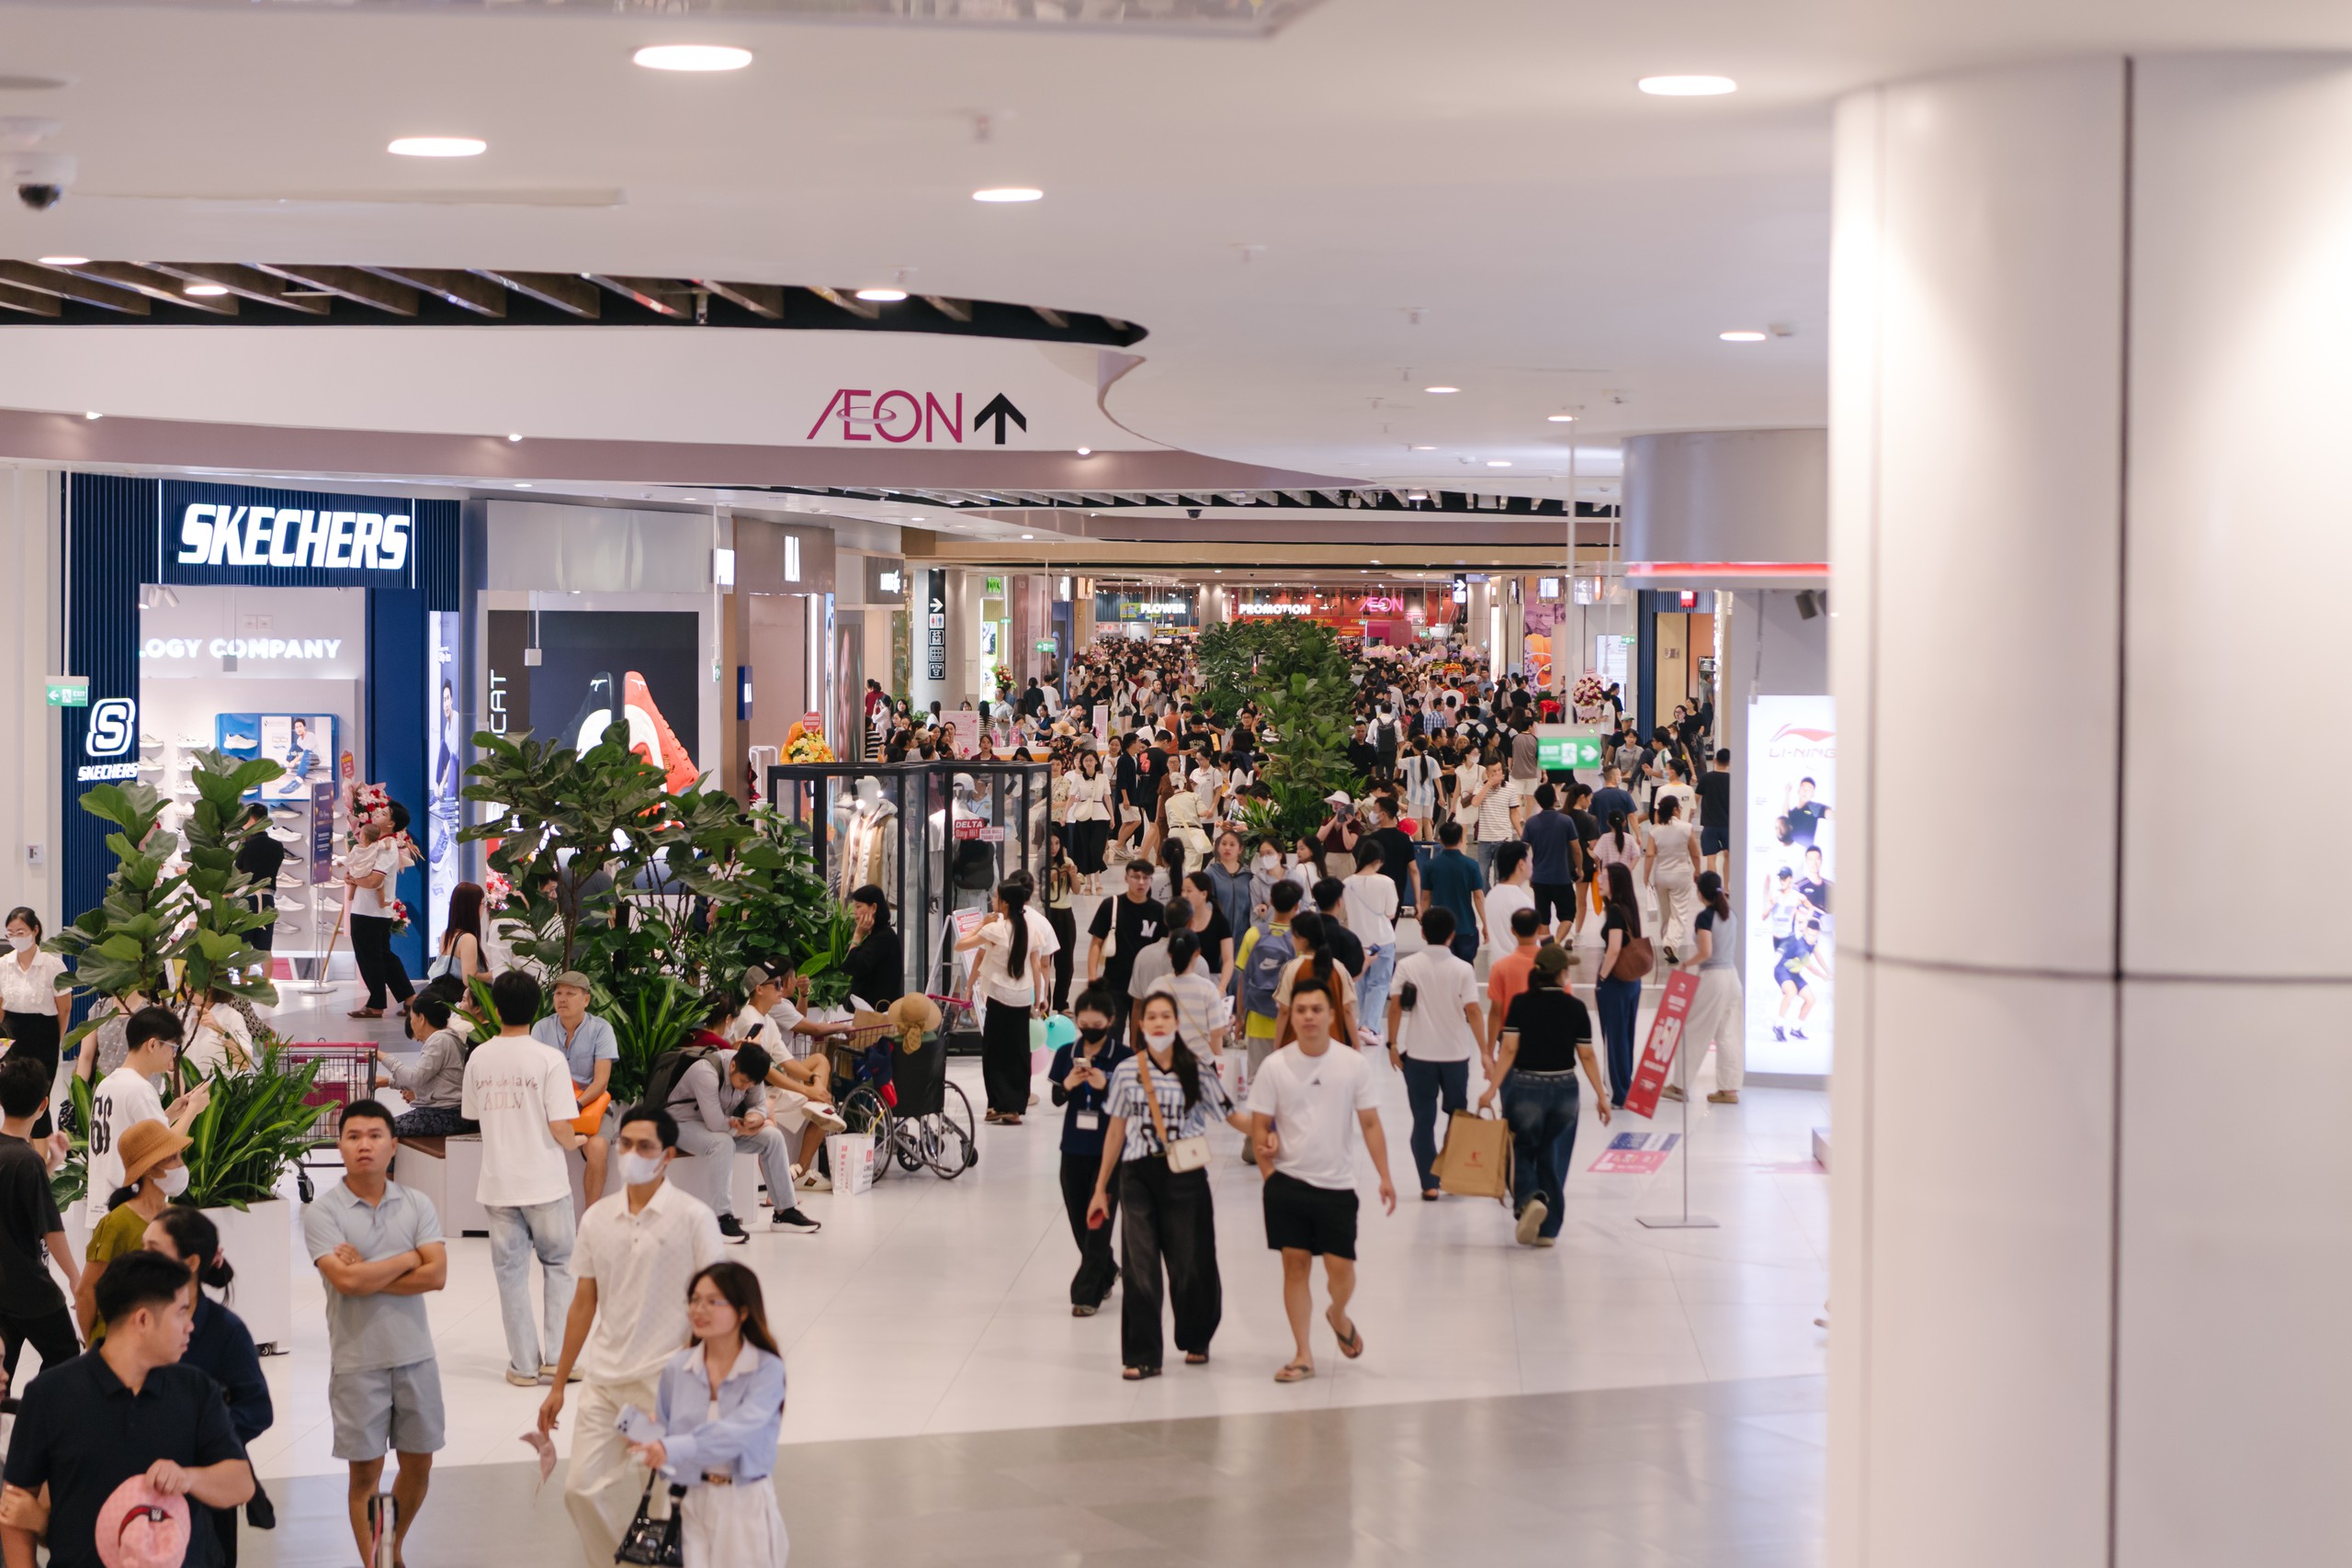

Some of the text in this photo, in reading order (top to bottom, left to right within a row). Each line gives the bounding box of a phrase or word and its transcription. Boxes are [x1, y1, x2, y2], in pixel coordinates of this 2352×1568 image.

[178, 502, 411, 570] SKECHERS
[1140, 603, 1186, 614] FLOWER
[1238, 604, 1311, 615] PROMOTION
[139, 637, 342, 659] OGY COMPANY
[1770, 748, 1837, 758] LI-NING
[77, 762, 139, 782] SKECHERS
[956, 820, 983, 829] DELTA
